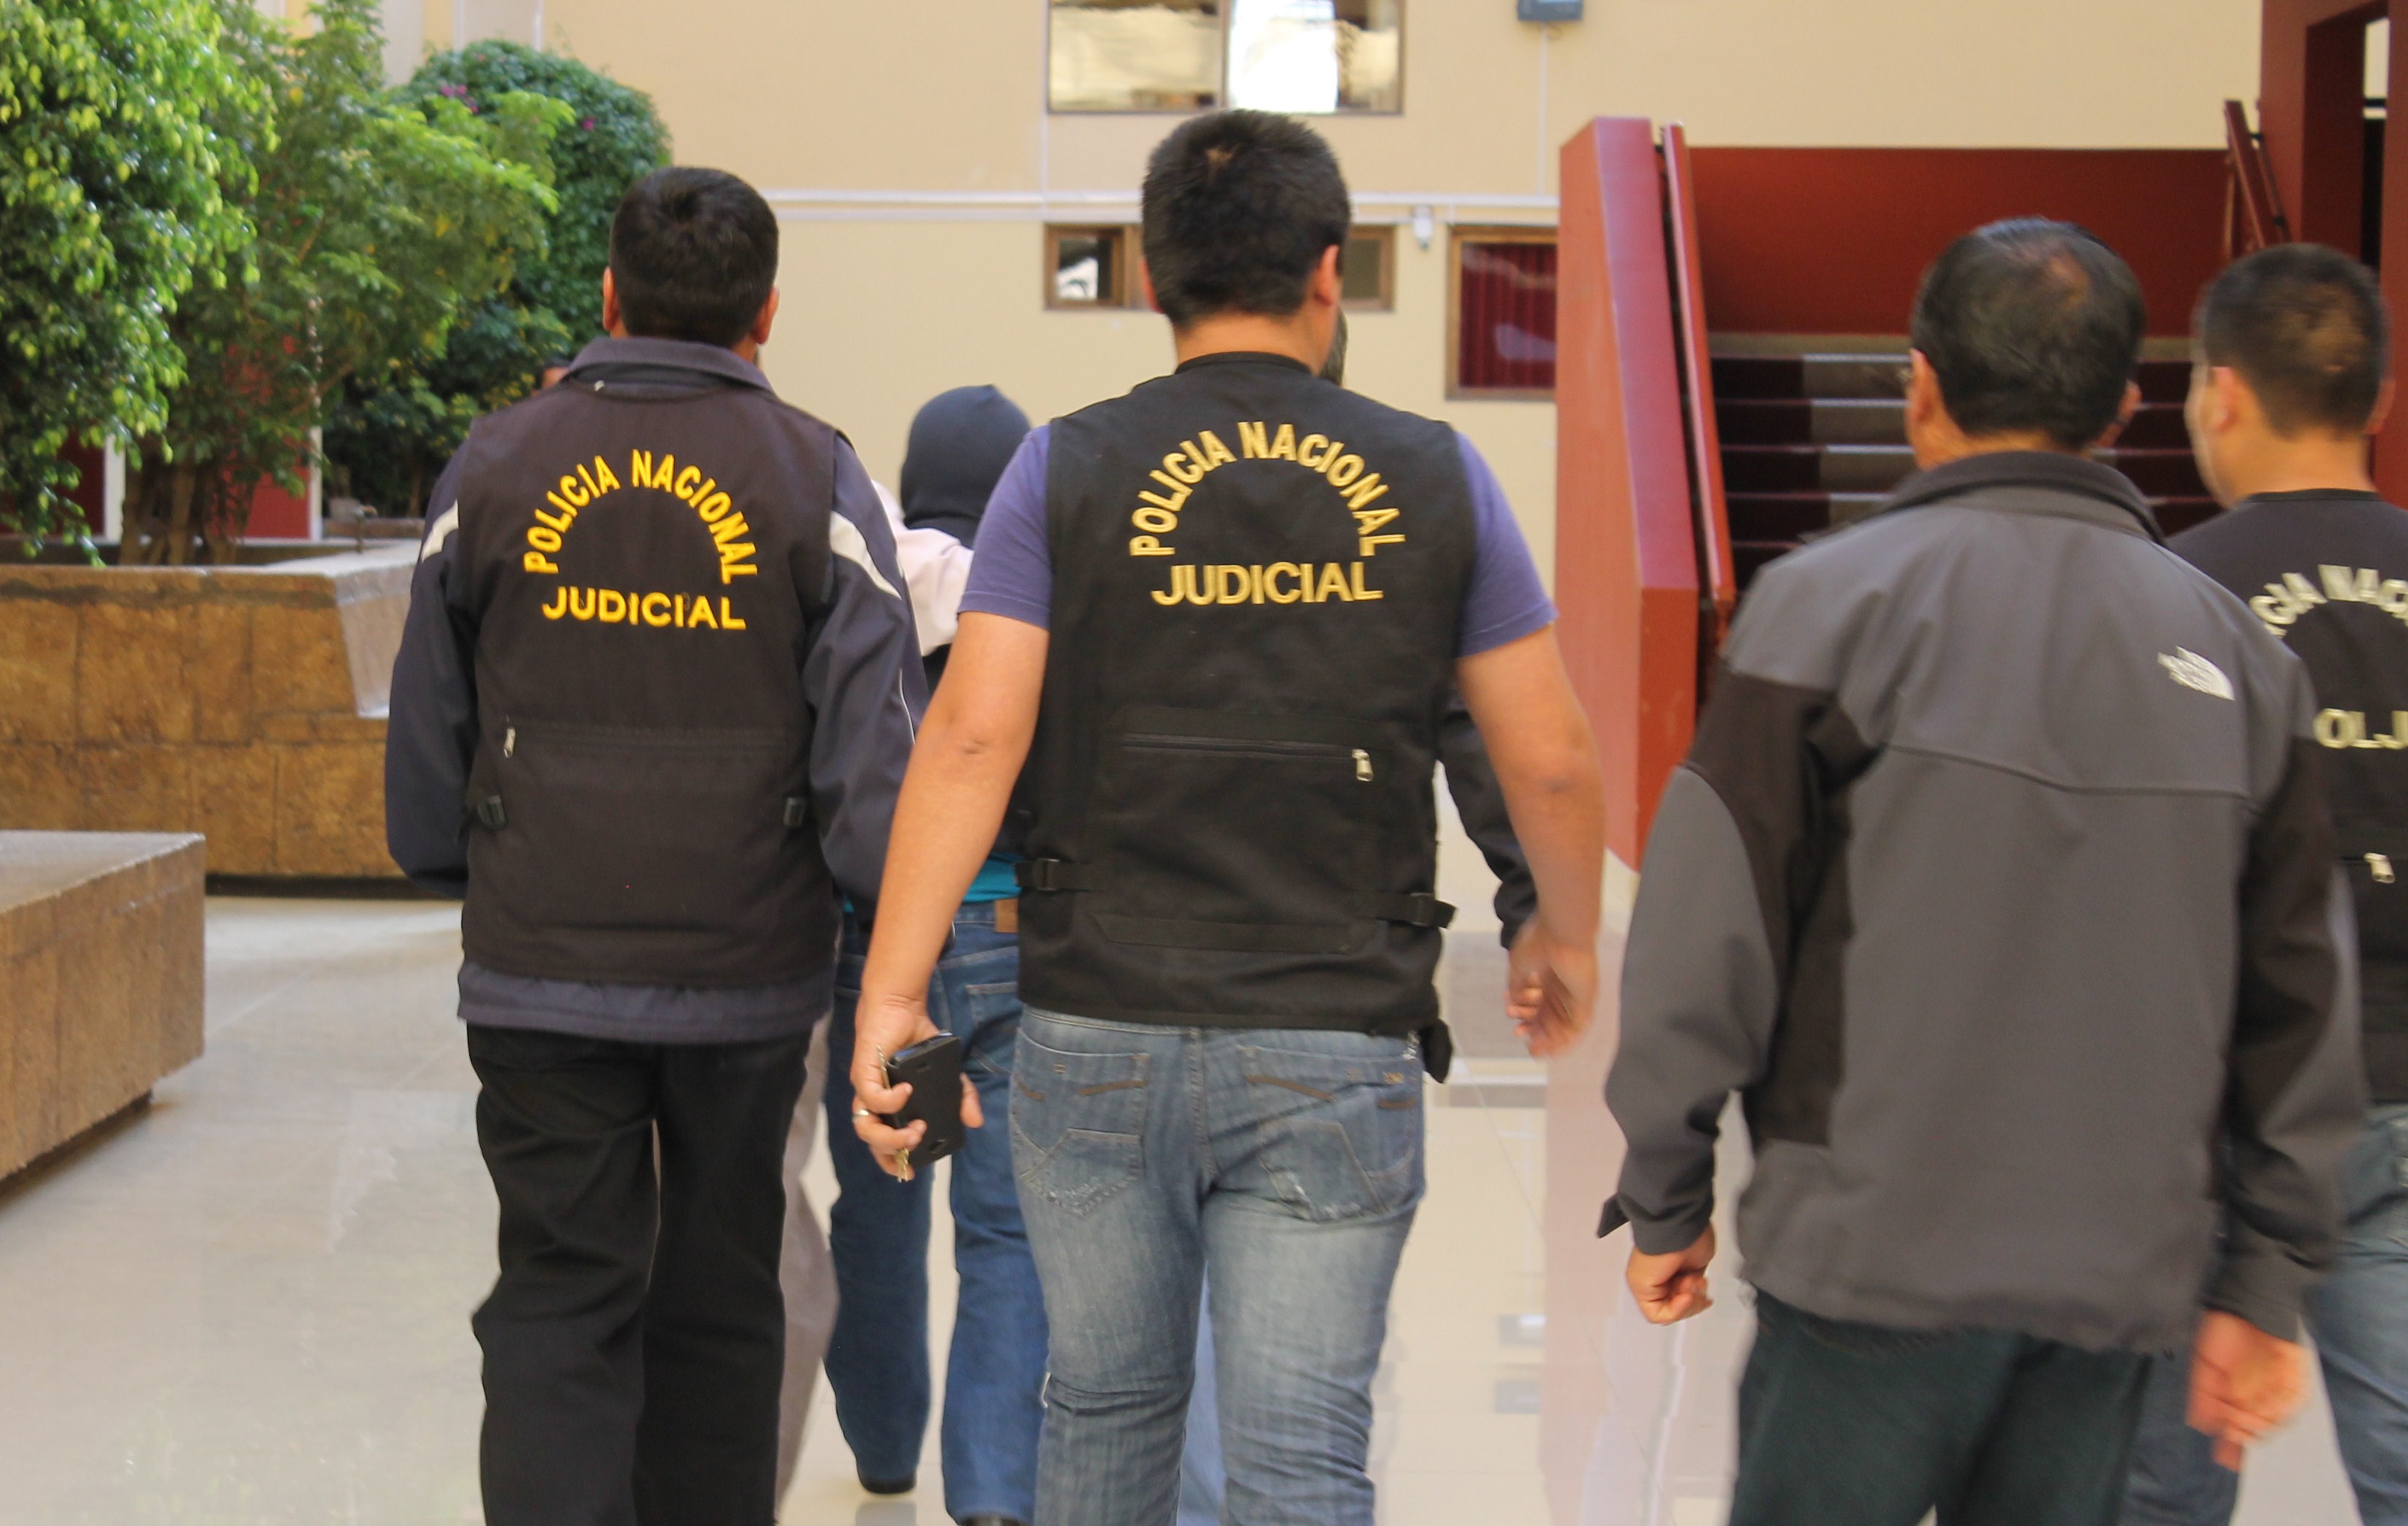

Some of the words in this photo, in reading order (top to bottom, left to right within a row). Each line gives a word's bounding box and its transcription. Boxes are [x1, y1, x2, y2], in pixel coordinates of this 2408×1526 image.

[523, 456, 621, 574] POLICIA
[631, 448, 758, 585] NACIONAL
[1129, 430, 1237, 556] POLICIA
[1237, 422, 1406, 556] NACIONAL
[542, 586, 746, 630] JUDICIAL
[1151, 562, 1384, 606] JUDICIAL
